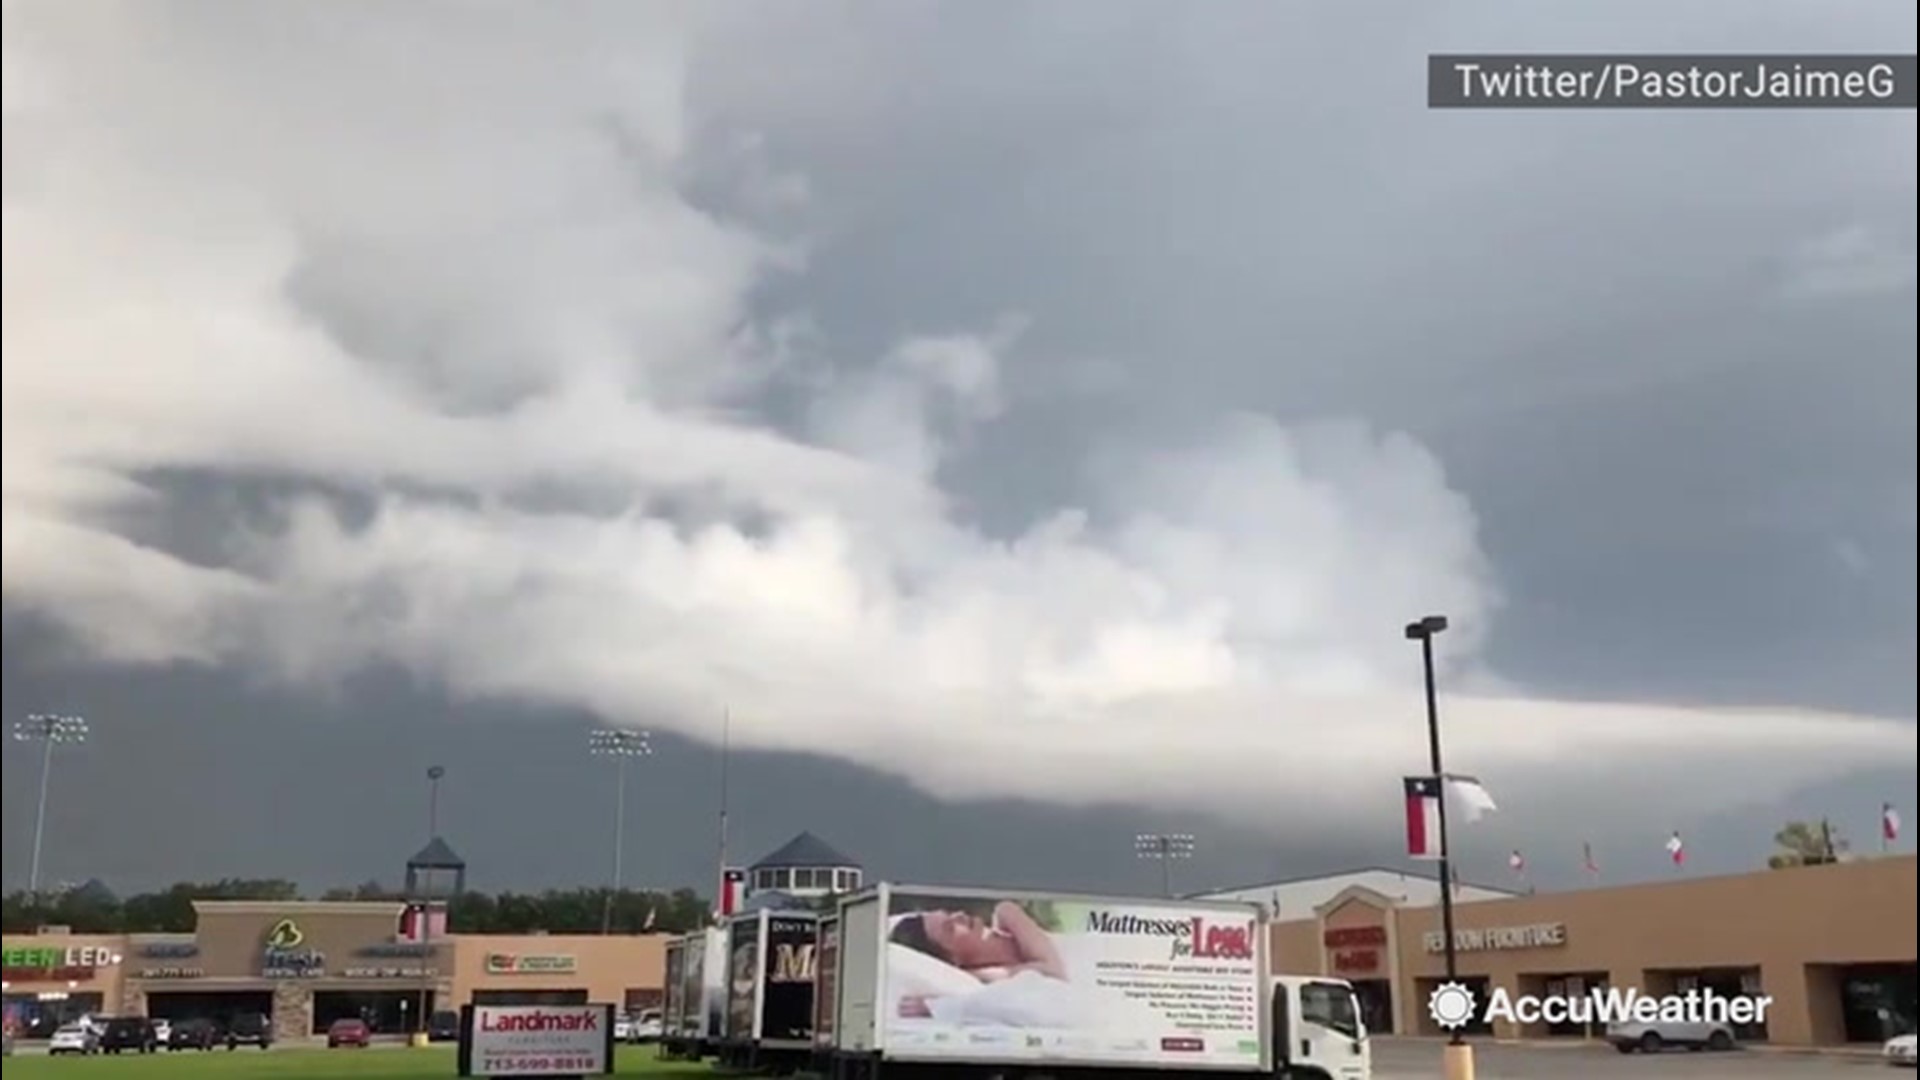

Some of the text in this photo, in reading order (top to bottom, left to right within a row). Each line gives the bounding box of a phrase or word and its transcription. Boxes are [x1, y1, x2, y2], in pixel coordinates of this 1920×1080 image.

[1087, 911, 1191, 937] Mattresses
[1169, 916, 1256, 960] for Less!
[65, 946, 111, 967] LED
[481, 1009, 597, 1032] Landmark
